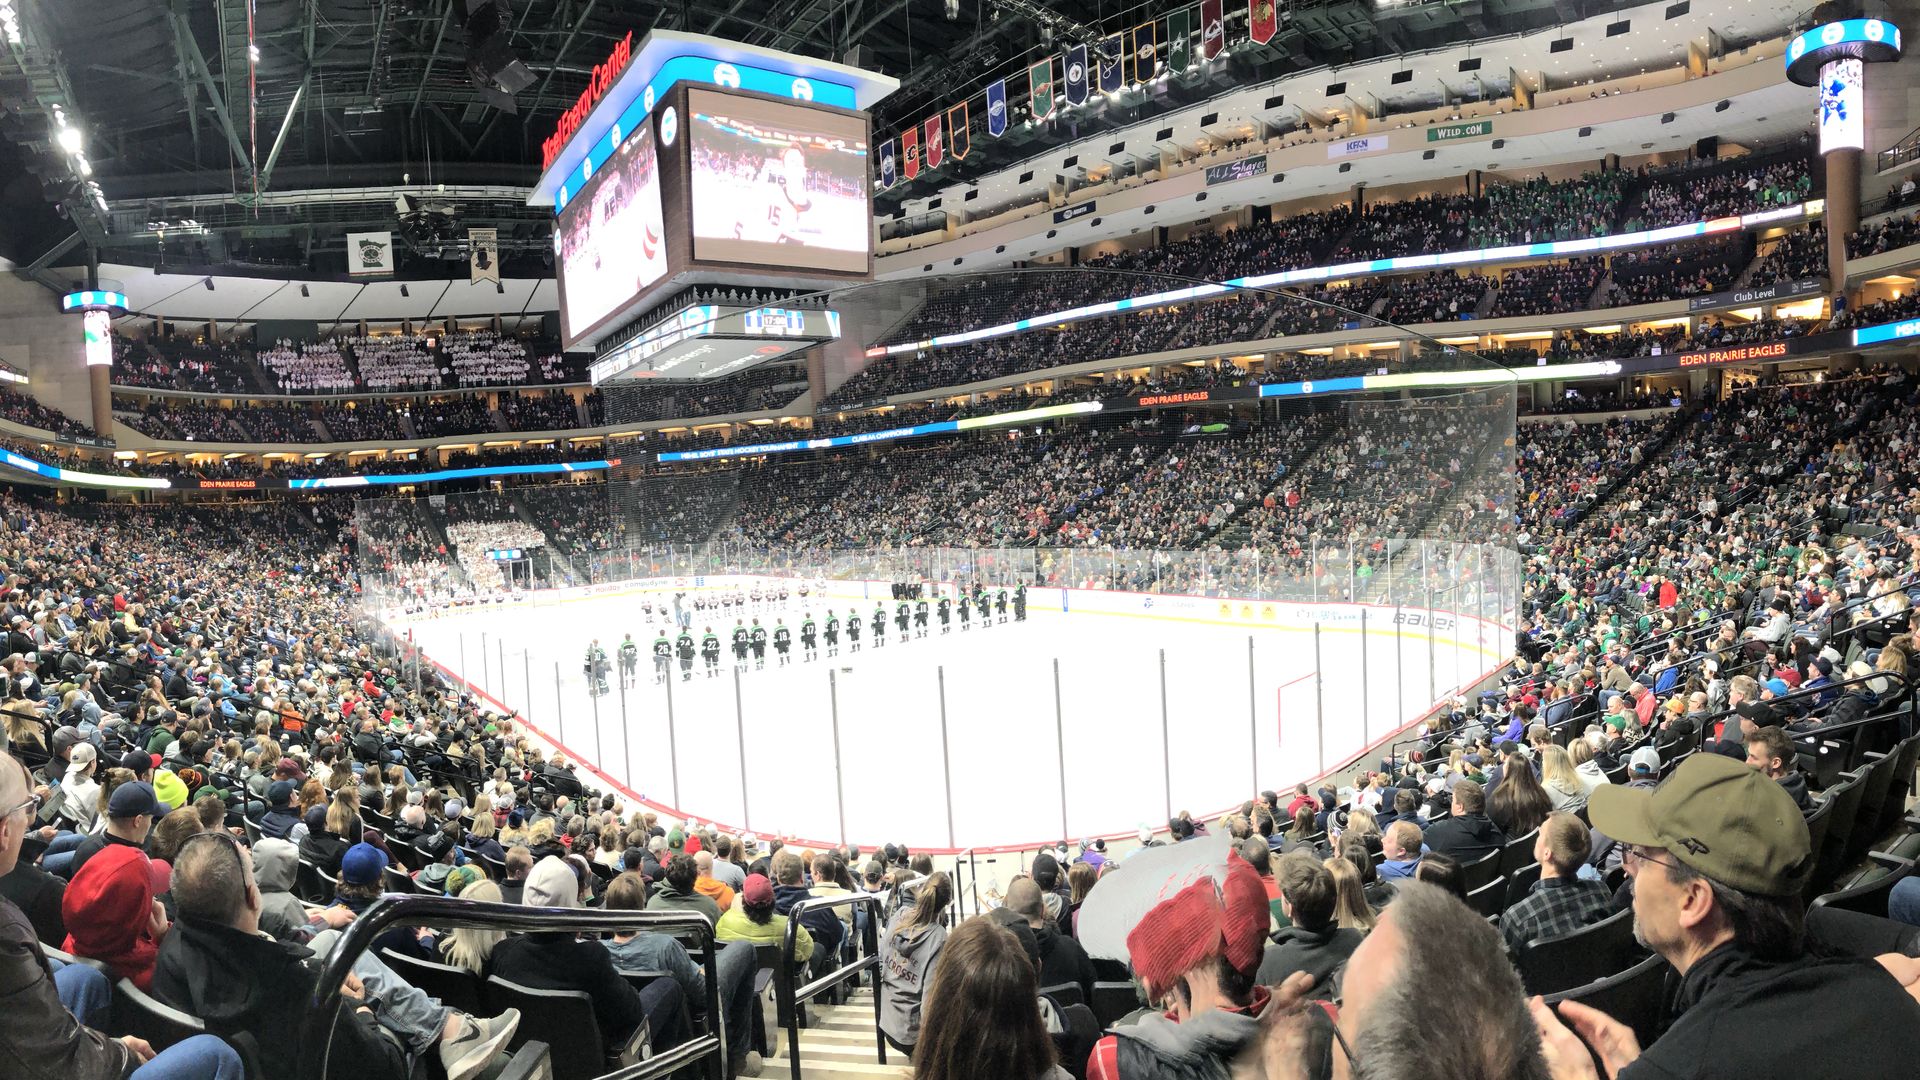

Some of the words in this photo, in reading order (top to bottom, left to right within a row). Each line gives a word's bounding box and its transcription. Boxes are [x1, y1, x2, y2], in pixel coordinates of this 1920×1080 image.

[542, 119, 563, 170] Xcel
[561, 81, 593, 143] Energy
[591, 30, 633, 100] Center
[1437, 123, 1483, 139] WILD.COM
[767, 205, 781, 226] 15
[1734, 291, 1753, 302] Club
[1754, 287, 1776, 299] Level
[1680, 353, 1707, 366] EDEN
[1709, 348, 1747, 363] PRAIRIE
[1748, 343, 1786, 358] EAGLES
[1140, 397, 1158, 406] EDEN
[1184, 392, 1208, 402] EAGLES
[75, 436, 84, 444] Club
[84, 438, 96, 446] Level
[235, 480, 256, 488] EAGLES
[806, 625, 815, 635] 17
[737, 632, 747, 642] 21
[657, 644, 669, 656] 26
[707, 640, 717, 651] 22
